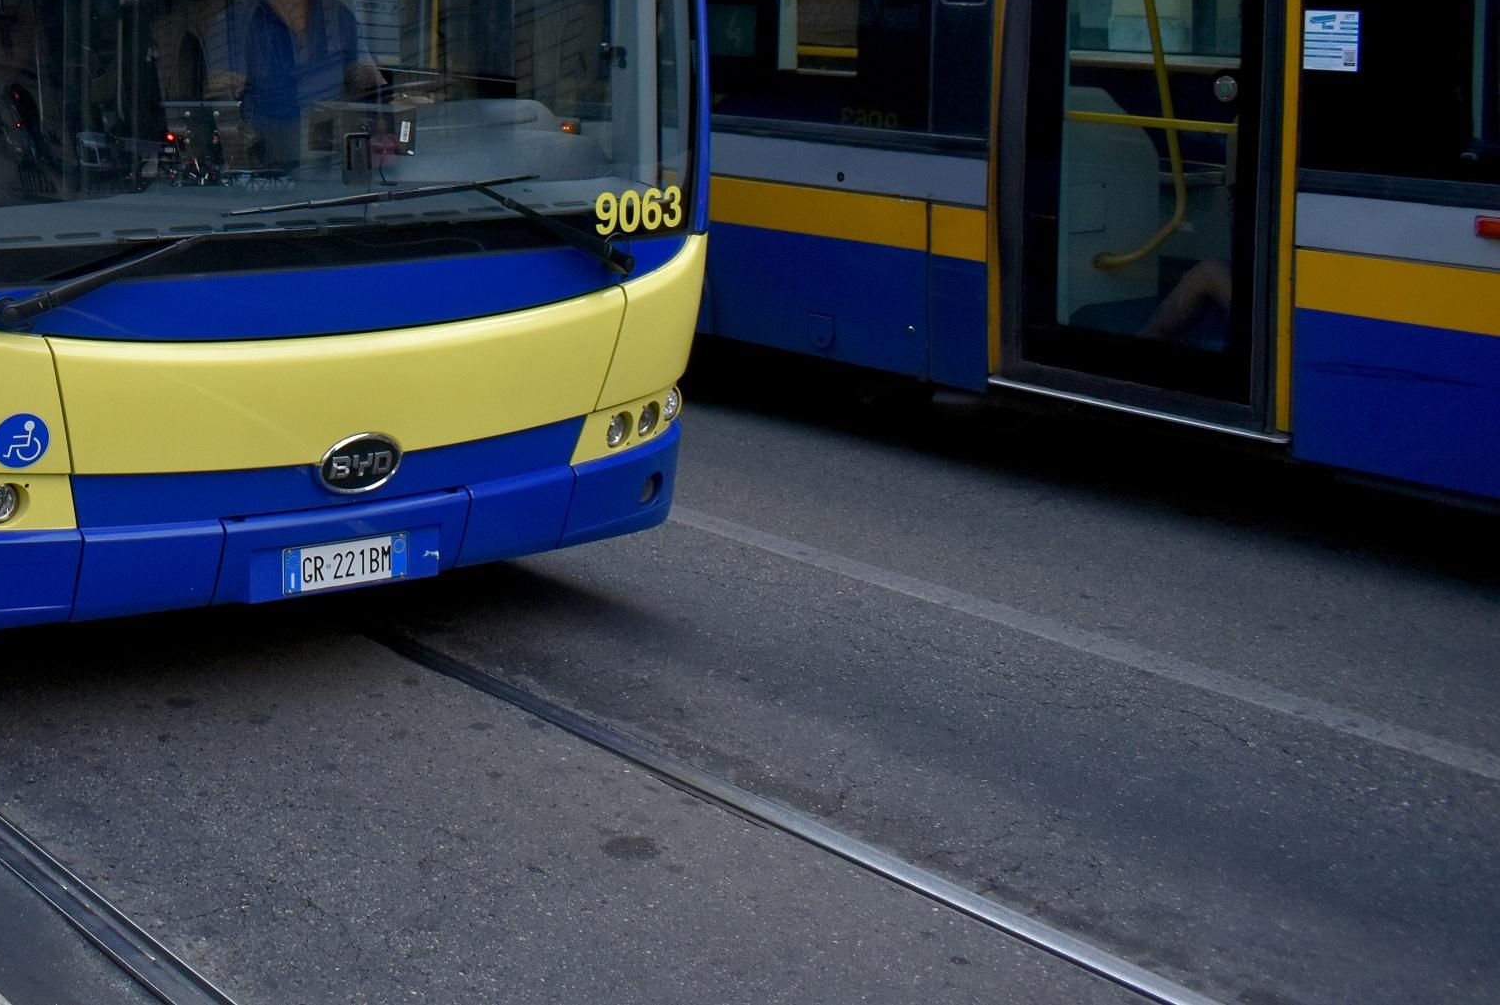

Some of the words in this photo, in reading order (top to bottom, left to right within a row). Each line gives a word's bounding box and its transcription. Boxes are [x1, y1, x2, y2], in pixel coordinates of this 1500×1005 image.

[595, 185, 682, 236] 9063
[328, 449, 393, 480] BYD
[302, 555, 325, 584] GR
[332, 544, 392, 580] 221BM
